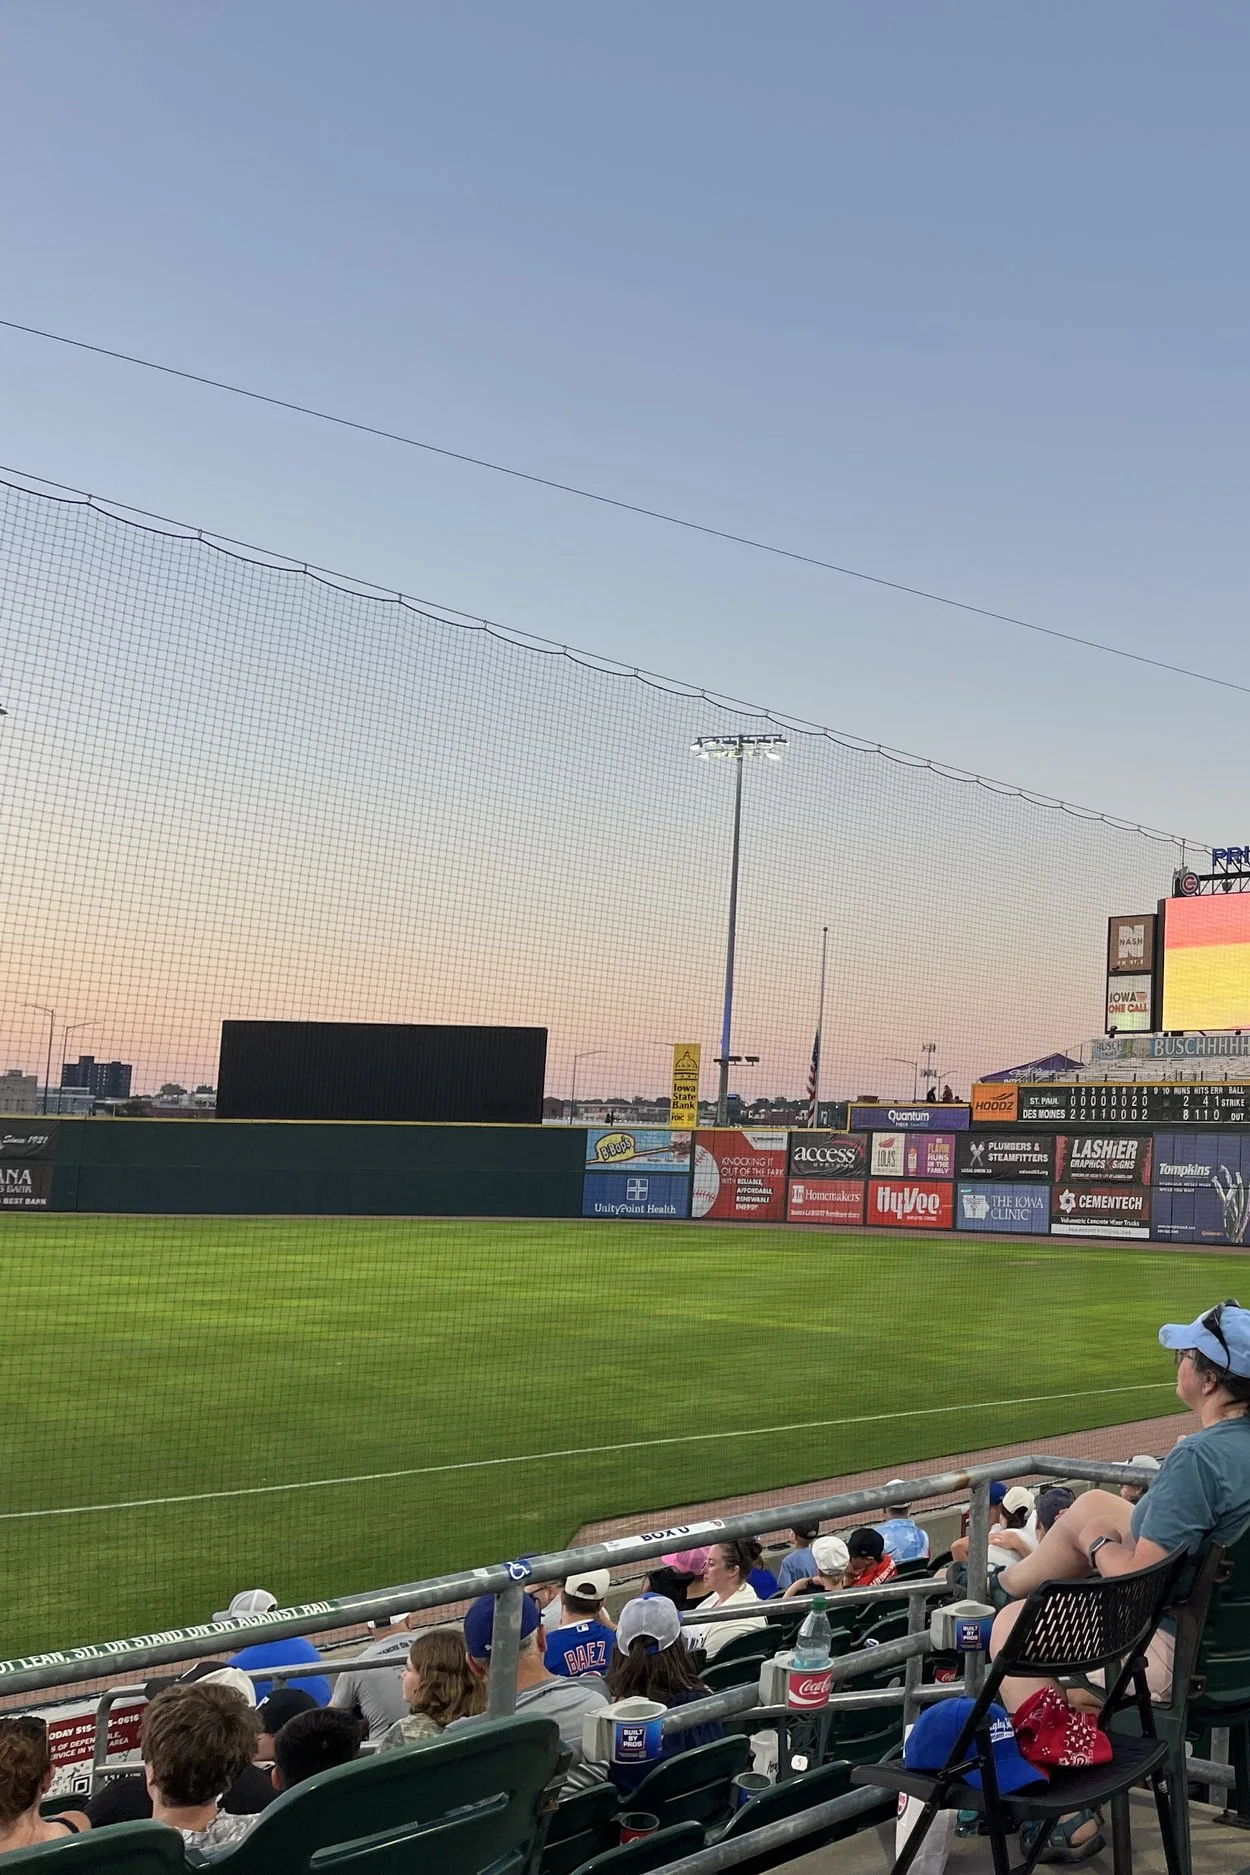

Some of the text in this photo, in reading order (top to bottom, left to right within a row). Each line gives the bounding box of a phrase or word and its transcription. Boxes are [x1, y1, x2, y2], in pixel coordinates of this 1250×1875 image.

[1120, 938, 1143, 946] NASH
[1110, 992, 1136, 1003] IOWA
[1108, 1003, 1148, 1013] ONE CALL
[1096, 1040, 1122, 1050] BUSCH
[674, 1084, 696, 1092] Iowa
[673, 1092, 696, 1100] State
[1071, 1096, 1075, 1106] 0
[1081, 1096, 1085, 1106] 0
[1091, 1096, 1096, 1106] 0
[1101, 1096, 1106, 1106] 0
[1111, 1096, 1116, 1106] 0
[1122, 1096, 1126, 1106] 0
[1132, 1096, 1137, 1106] 2
[1142, 1096, 1147, 1106] 0
[1183, 1096, 1189, 1106] 2
[1203, 1096, 1208, 1106] 4
[1215, 1096, 1219, 1106] 1
[672, 1101, 696, 1110] Bank
[976, 1101, 1014, 1111] HOODZ
[888, 1110, 930, 1123] Quantum
[1023, 1109, 1037, 1119] DES
[1038, 1109, 1066, 1119] MOINES
[1070, 1109, 1075, 1120] 2
[1080, 1109, 1085, 1120] 2
[1092, 1109, 1096, 1120] 1
[1101, 1109, 1105, 1120] 1
[1111, 1109, 1116, 1120] 0
[1121, 1109, 1126, 1120] 0
[1131, 1109, 1137, 1120] 0
[1142, 1109, 1147, 1120] 2
[1183, 1109, 1188, 1120] 8
[1214, 1109, 1220, 1120] 0
[988, 1142, 1040, 1151] PLUMBERS &
[794, 1146, 856, 1162] access
[878, 1150, 896, 1167] LOLA'S
[988, 1153, 1048, 1162] STEAMFITTERS
[721, 1157, 774, 1166] KNOCKING IT
[721, 1167, 738, 1177] OUT
[740, 1168, 751, 1177] OF
[752, 1168, 765, 1176] THE
[1160, 1163, 1210, 1177] Tompkins
[805, 1189, 861, 1202] Homemakers
[991, 1195, 1044, 1209] THE IOWA
[1079, 1195, 1143, 1210] CEMENTECH
[595, 1203, 676, 1215] UnityPoint Health
[991, 1208, 1030, 1220] CLINIC
[641, 1530, 676, 1541] BOX
[21, 1602, 336, 1670] LEAN, SIT, OR STAND ON OR AGAINST RAIL
[564, 1641, 606, 1676] BAEZ
[57, 1743, 68, 1751] OF
[109, 1737, 129, 1747] AREA
